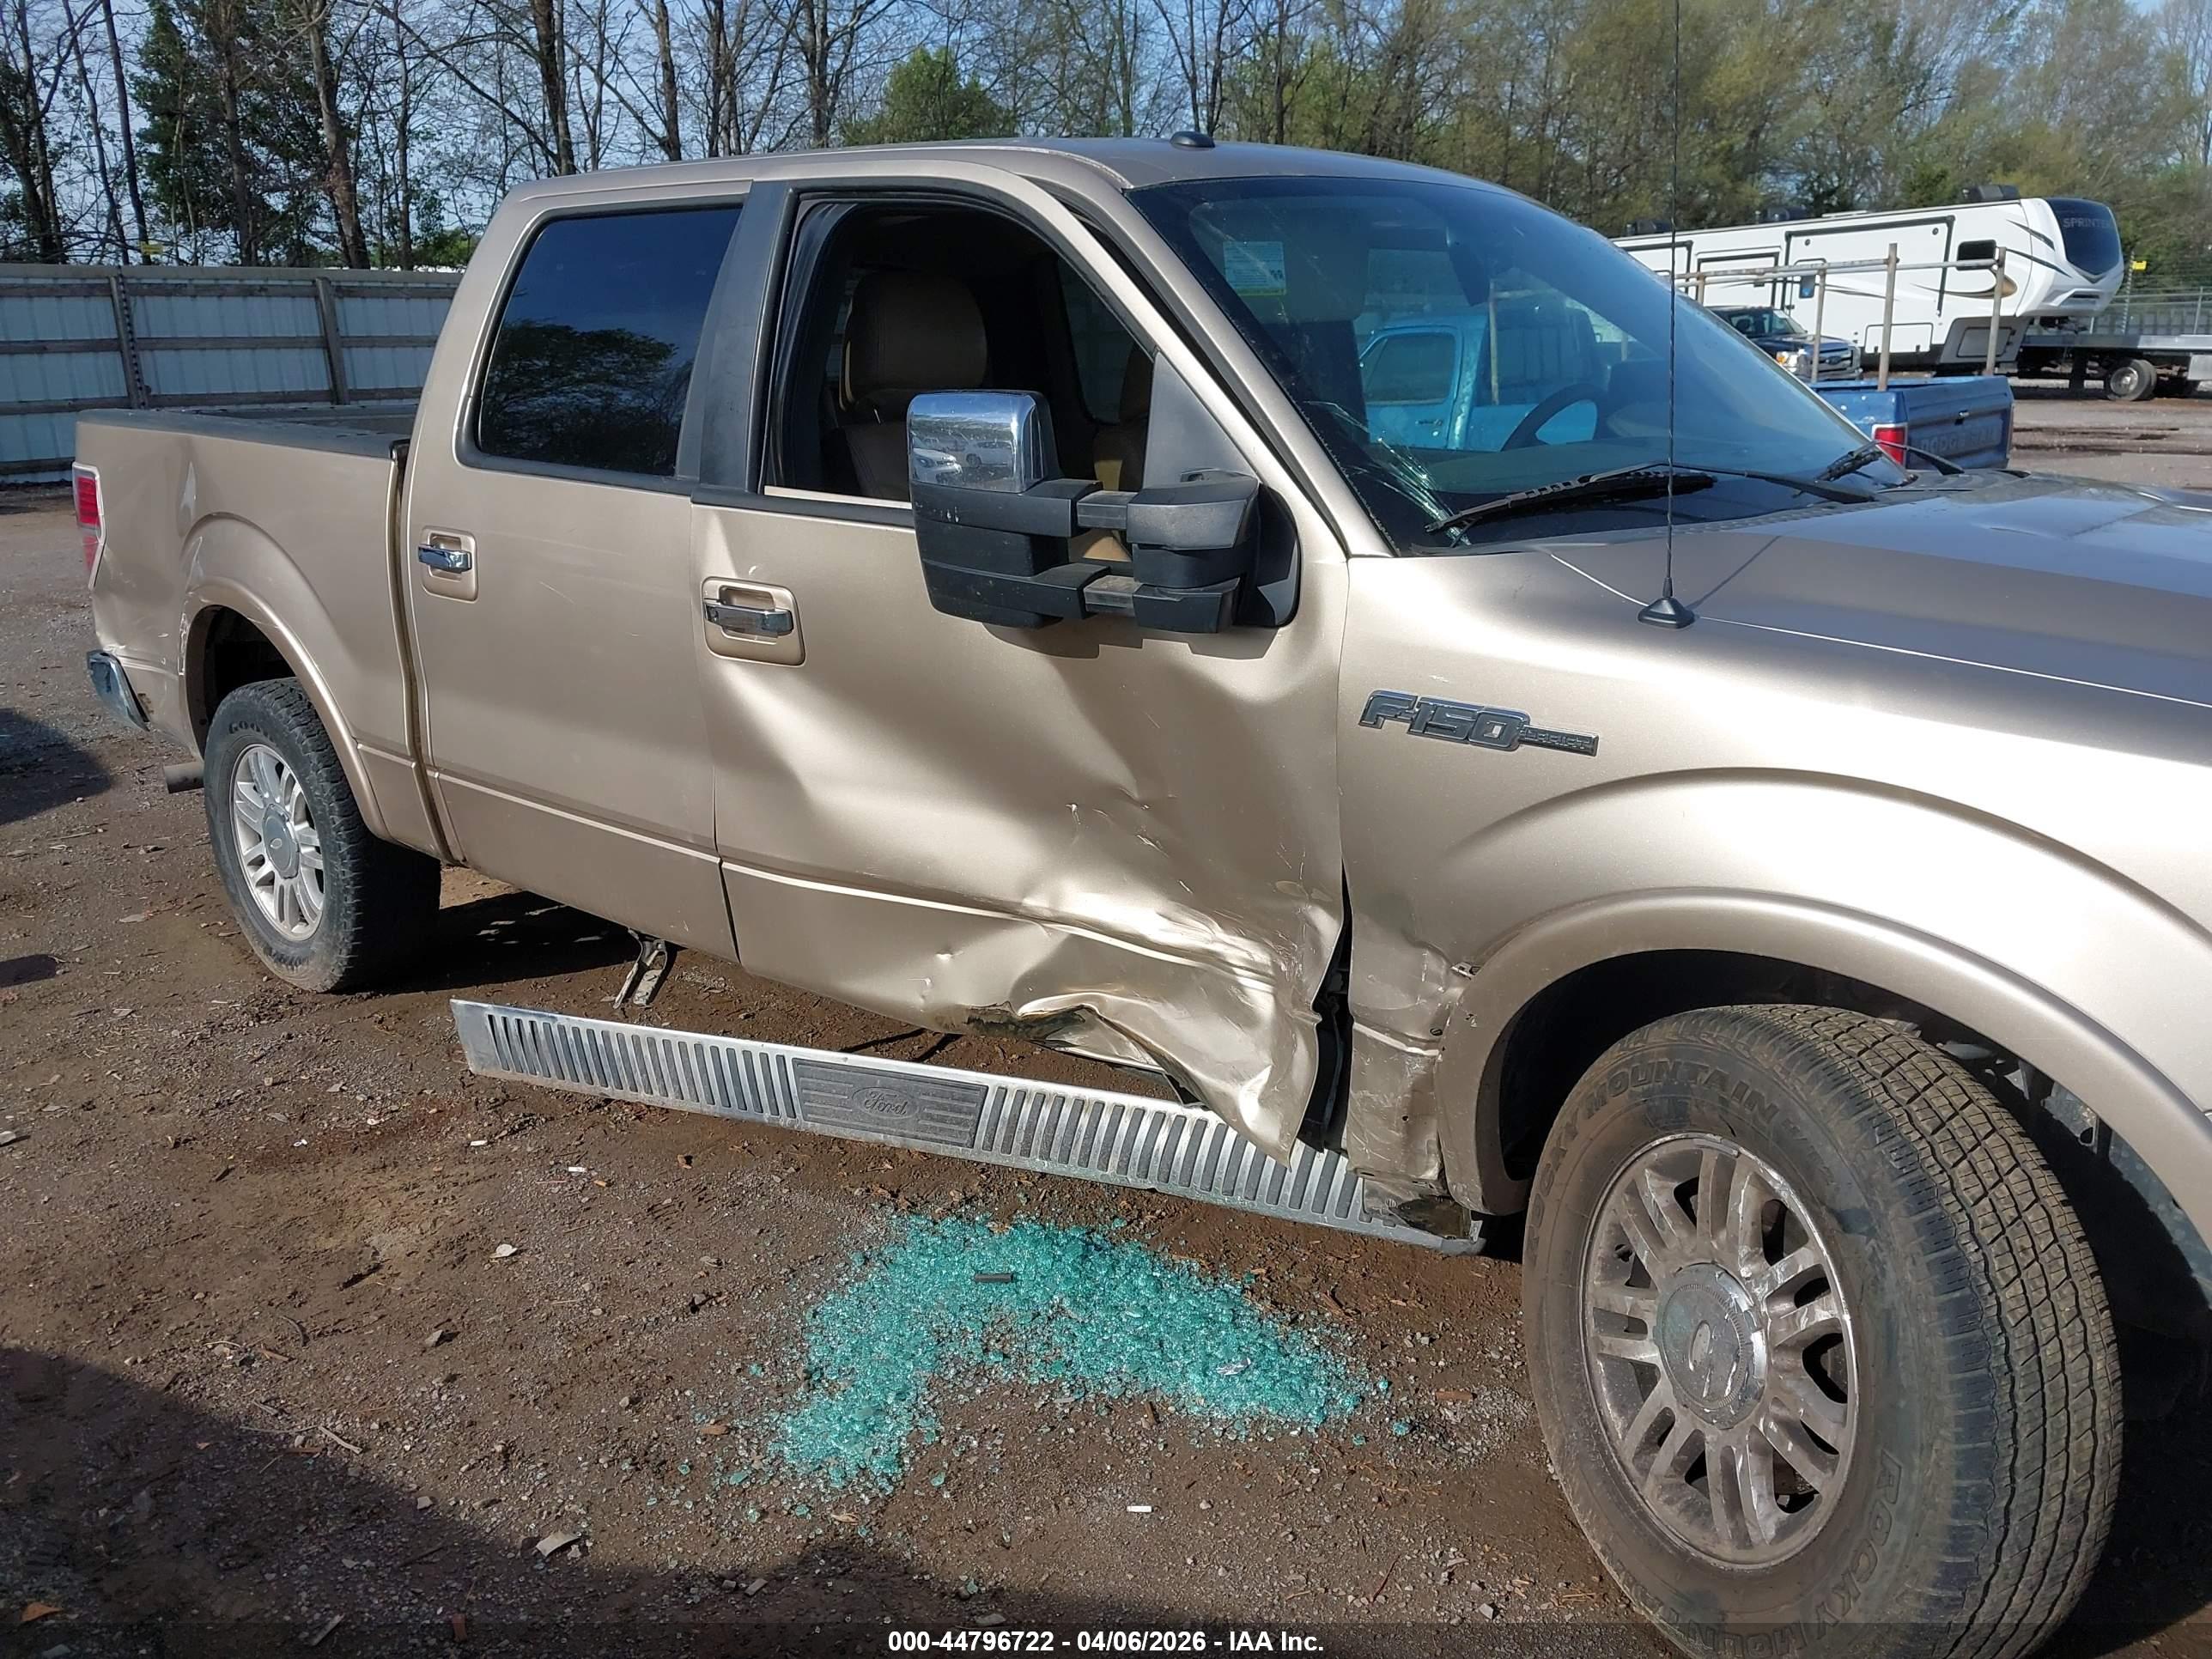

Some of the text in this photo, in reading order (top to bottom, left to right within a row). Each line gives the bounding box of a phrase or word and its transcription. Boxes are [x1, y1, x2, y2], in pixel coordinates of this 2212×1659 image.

[1358, 689, 1531, 752] F-150
[863, 1090, 909, 1116] Ford
[1582, 1057, 1780, 1126] MOUNTAIN
[1814, 1448, 1904, 1641] ROCKY
